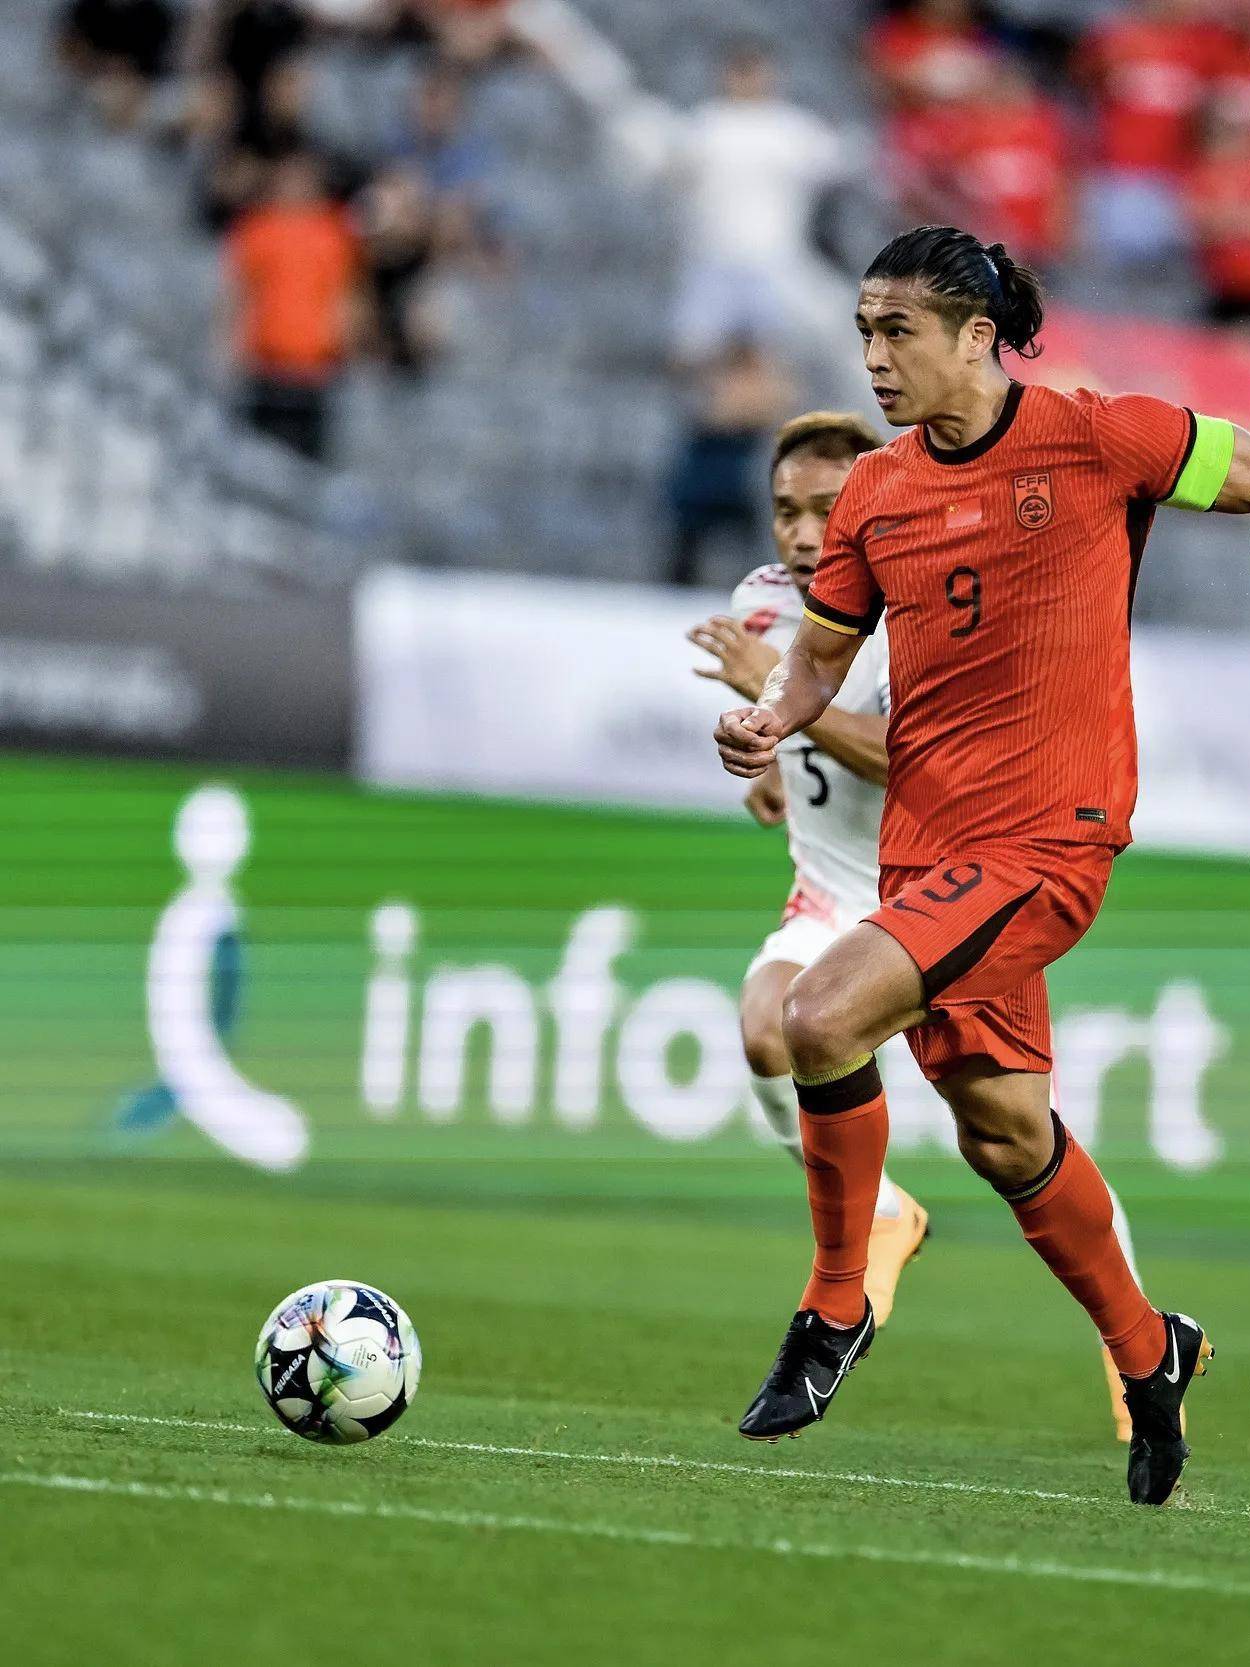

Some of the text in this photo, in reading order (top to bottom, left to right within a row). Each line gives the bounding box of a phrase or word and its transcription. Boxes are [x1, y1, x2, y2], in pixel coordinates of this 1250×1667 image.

[1016, 475, 1048, 489] CFA
[945, 565, 981, 637] 9
[800, 746, 829, 806] 5
[920, 862, 983, 903] 9
[362, 903, 1232, 1172] infort
[273, 1353, 307, 1396] TSUBASA
[366, 1352, 378, 1363] 5
